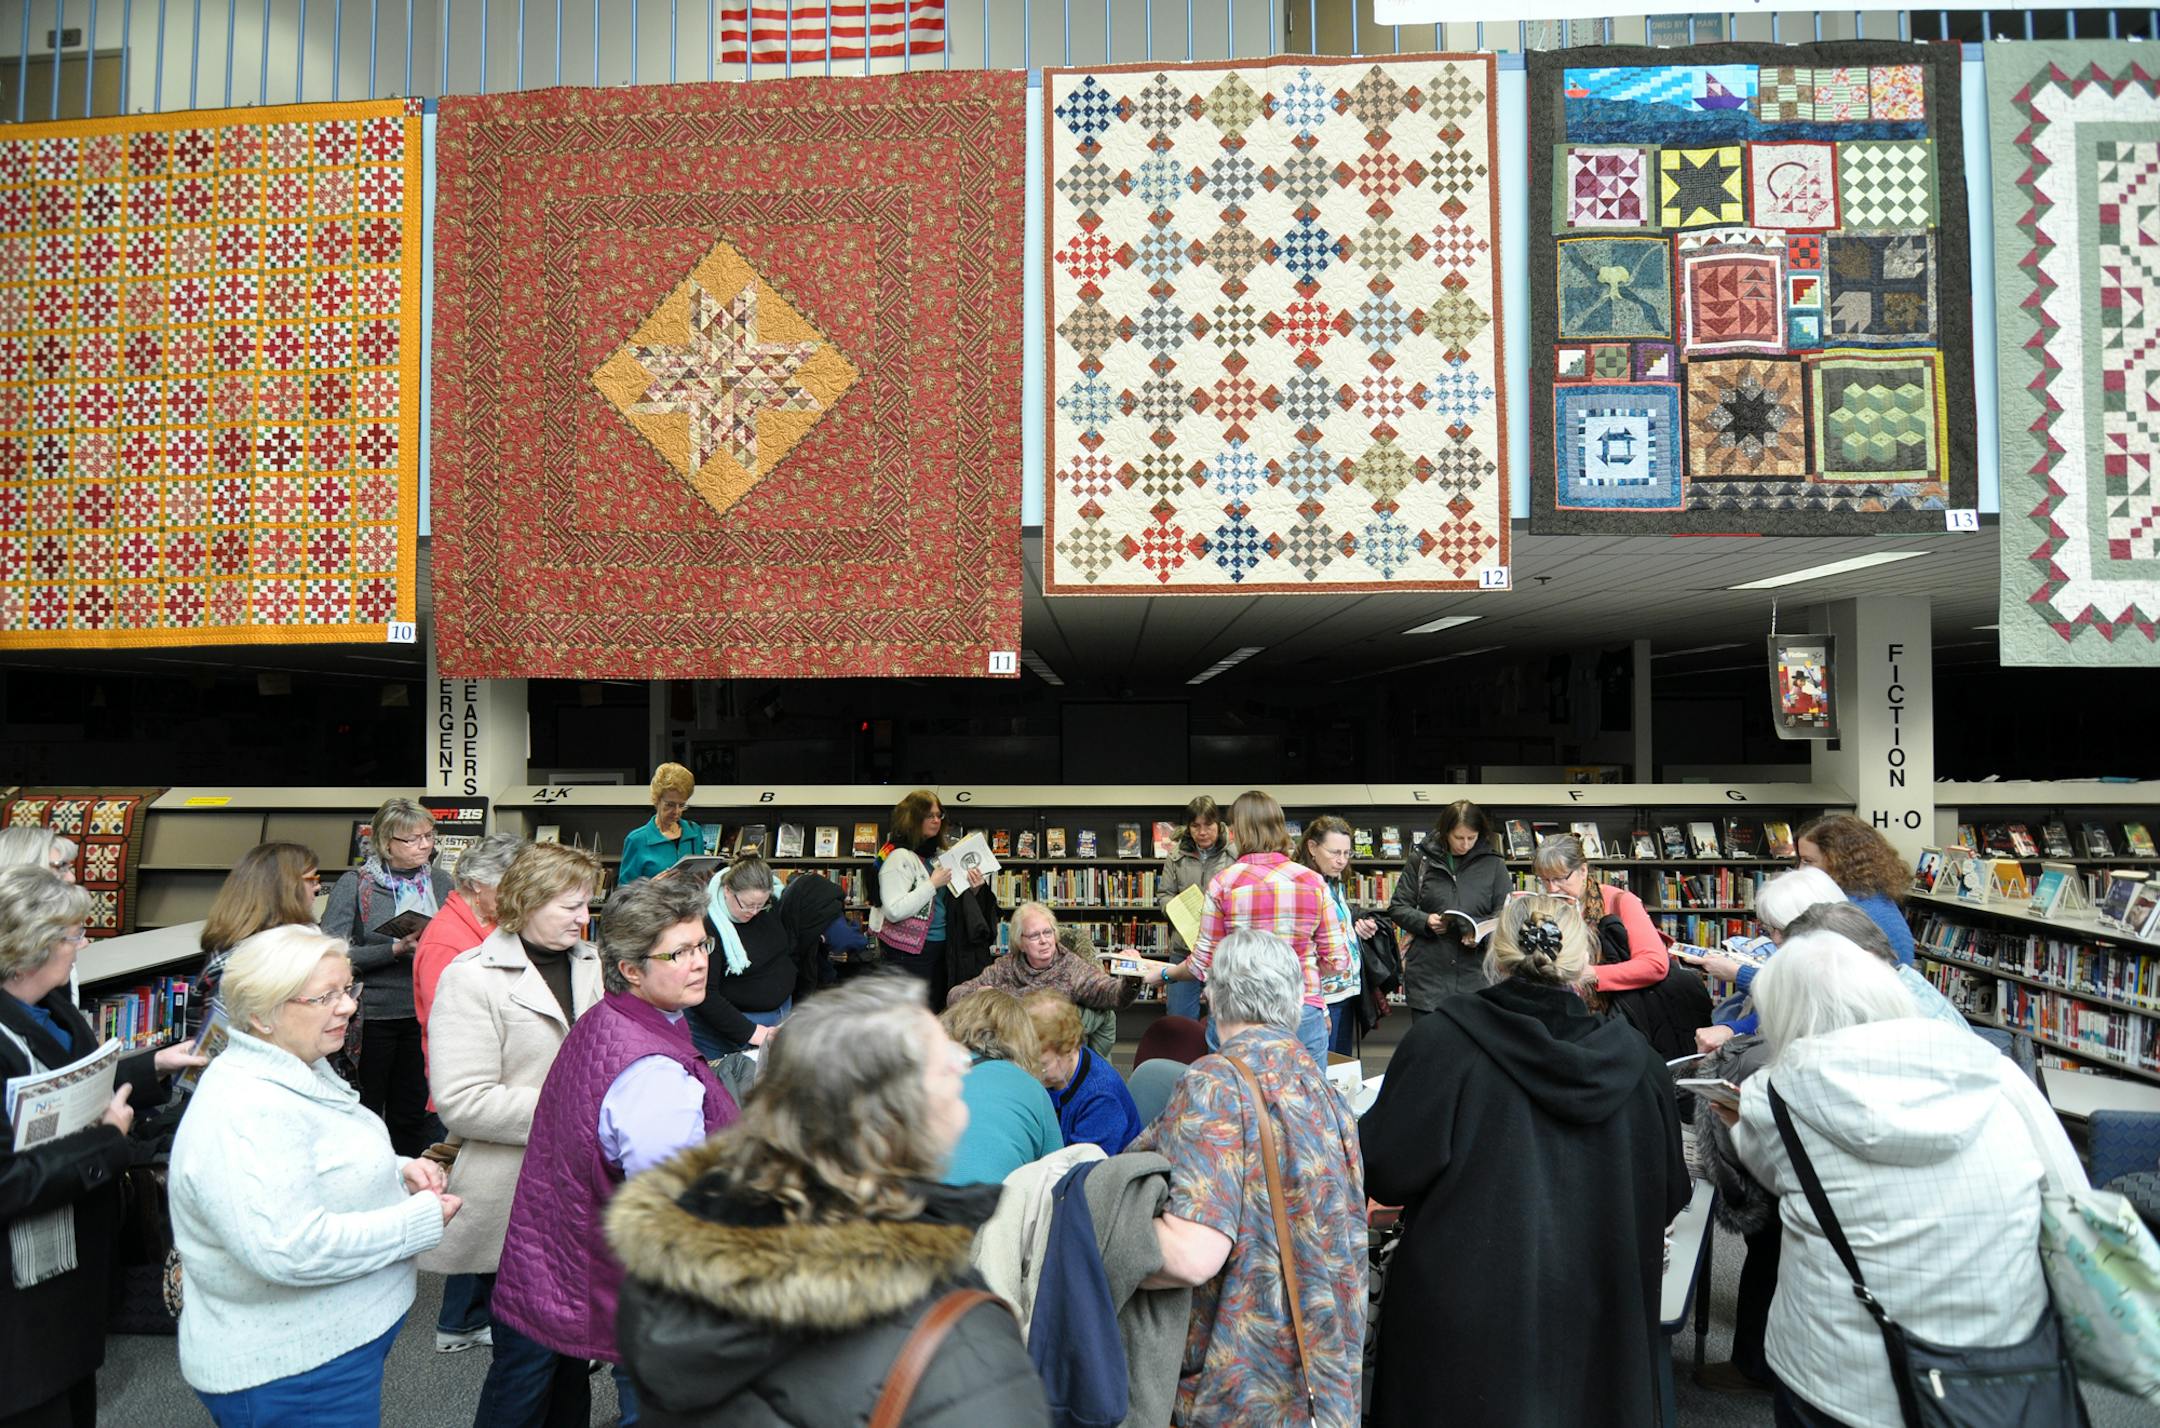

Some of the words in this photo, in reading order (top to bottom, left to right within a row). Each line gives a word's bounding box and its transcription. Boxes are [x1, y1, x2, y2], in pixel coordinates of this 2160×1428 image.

[1952, 513, 1973, 527] 13
[1483, 570, 1504, 585] 12
[392, 626, 412, 640] 10
[992, 655, 1011, 670] 11
[1888, 644, 1905, 787] FICTION
[464, 679, 477, 795] EADERS
[759, 791, 776, 802] B
[956, 791, 972, 802] C
[1413, 791, 1430, 801] E
[1568, 790, 1584, 801] F
[1725, 790, 1748, 802] G
